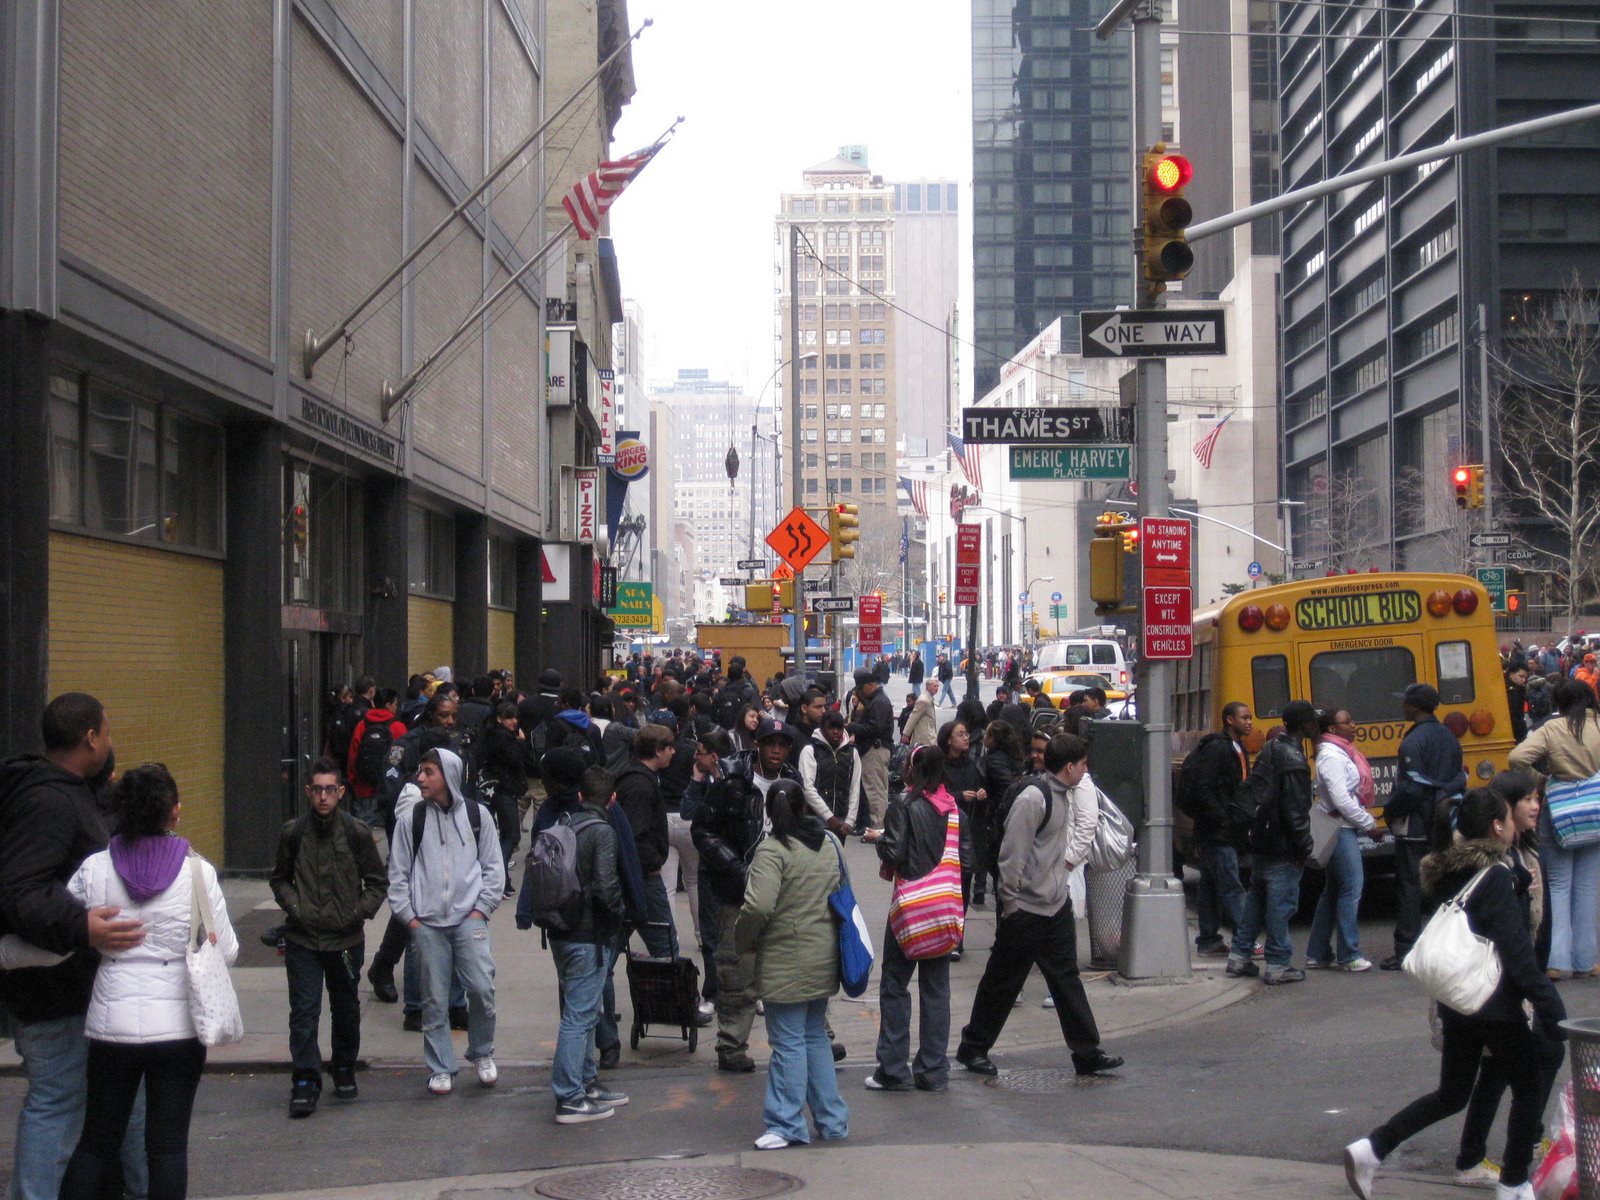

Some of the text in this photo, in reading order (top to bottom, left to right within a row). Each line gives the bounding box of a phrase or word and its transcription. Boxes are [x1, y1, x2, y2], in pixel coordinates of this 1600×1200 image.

[1104, 324, 1206, 343] ONE WAY
[602, 382, 611, 454] NAILS
[1021, 409, 1046, 419] 21-27
[966, 417, 1090, 438] THAMES ST
[614, 453, 646, 470] KING
[1014, 449, 1124, 468] EMERIC HARVEY
[1053, 468, 1086, 478] PLACE
[580, 481, 592, 538] PIZZA
[1147, 525, 1187, 536] NO STANDING
[1151, 540, 1182, 550] ANYTIME
[625, 588, 645, 598] SPA
[1310, 581, 1400, 596] www.atlanticexpress.com
[620, 600, 651, 609] NAILS
[1155, 593, 1181, 604] EXCEPT
[1160, 609, 1176, 619] WTC
[1299, 592, 1417, 629] SCHOOL BUS
[1146, 624, 1191, 636] CONSTRUCTION
[1152, 640, 1186, 651] VEHICLES
[1330, 638, 1394, 650] EMERGENCY DOOR
[1384, 766, 1390, 778] A
